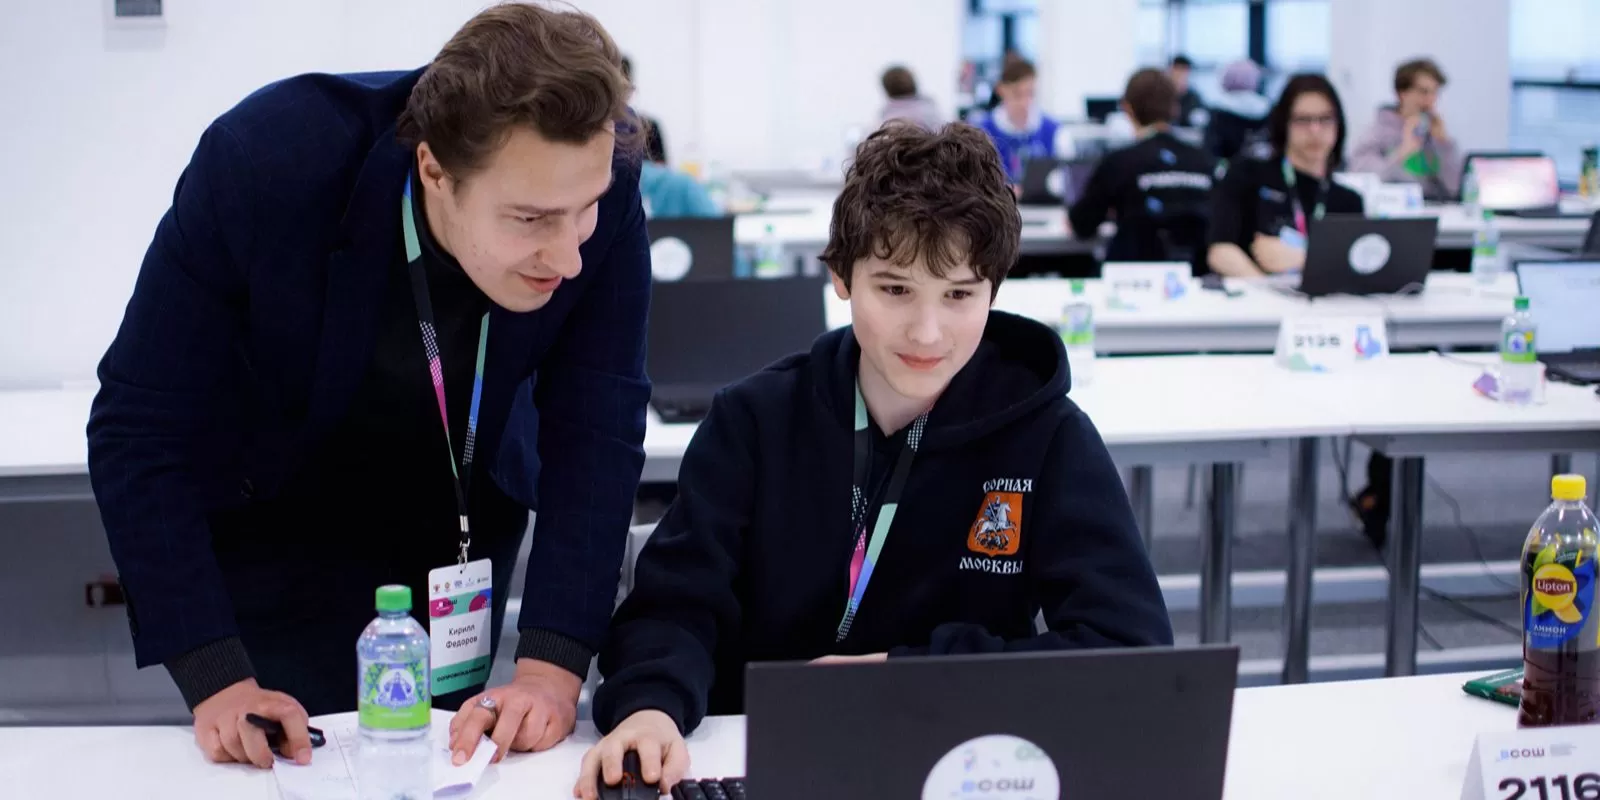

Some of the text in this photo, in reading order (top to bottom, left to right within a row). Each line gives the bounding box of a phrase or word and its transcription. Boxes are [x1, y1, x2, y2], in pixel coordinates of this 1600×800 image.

[959, 556, 1023, 574] МОСКВЫ
[1537, 579, 1571, 592] Lipton
[449, 624, 475, 636] Кирилл
[445, 636, 478, 649] Федоров
[1498, 772, 1600, 800] 2116
